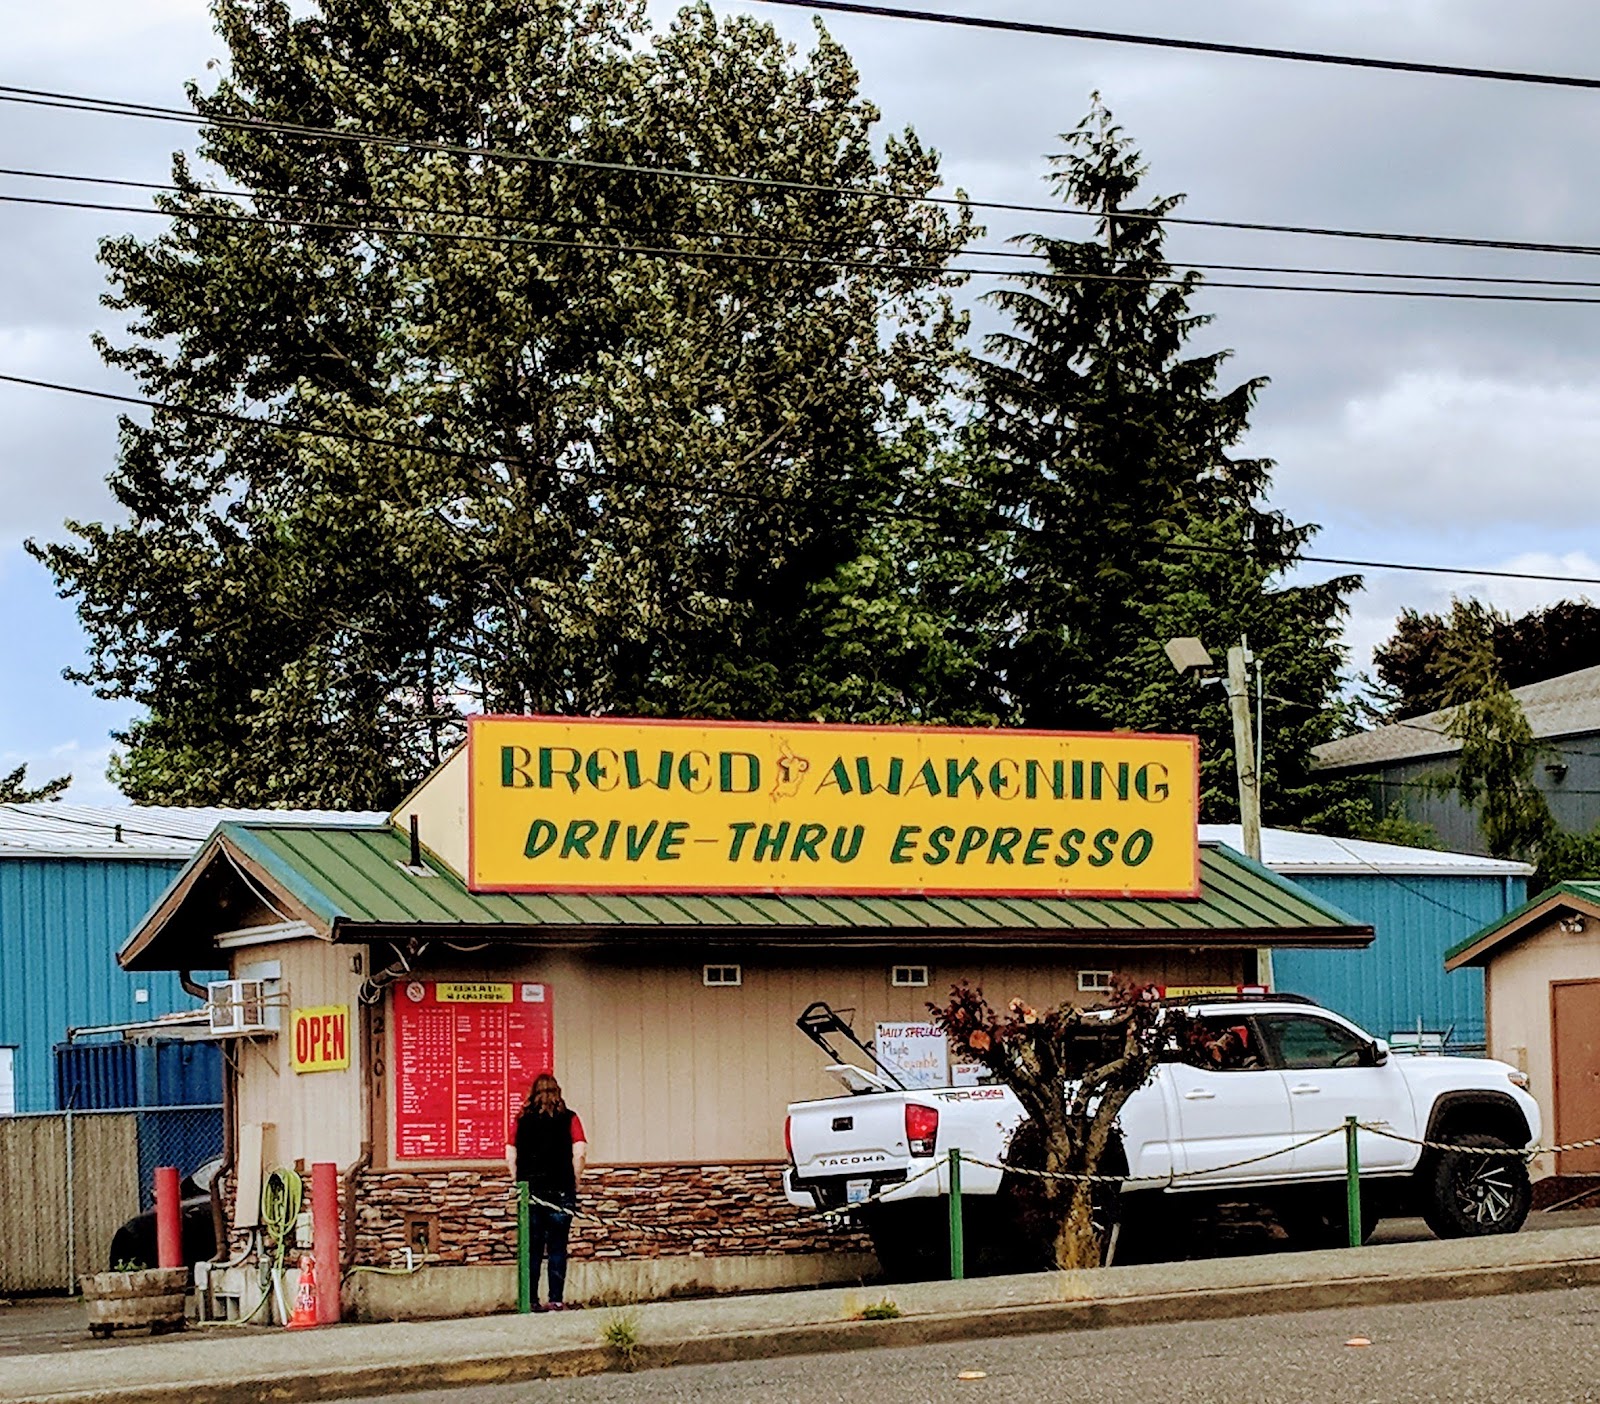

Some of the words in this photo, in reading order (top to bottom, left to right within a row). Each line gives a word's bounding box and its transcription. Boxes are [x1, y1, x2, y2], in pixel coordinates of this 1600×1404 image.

[501, 745, 762, 794] BREWED
[814, 755, 1170, 803] AWAKENING
[889, 824, 1154, 867] ESPRESSO
[295, 1012, 345, 1064] OPEN
[819, 1155, 885, 1167] TACOMA
